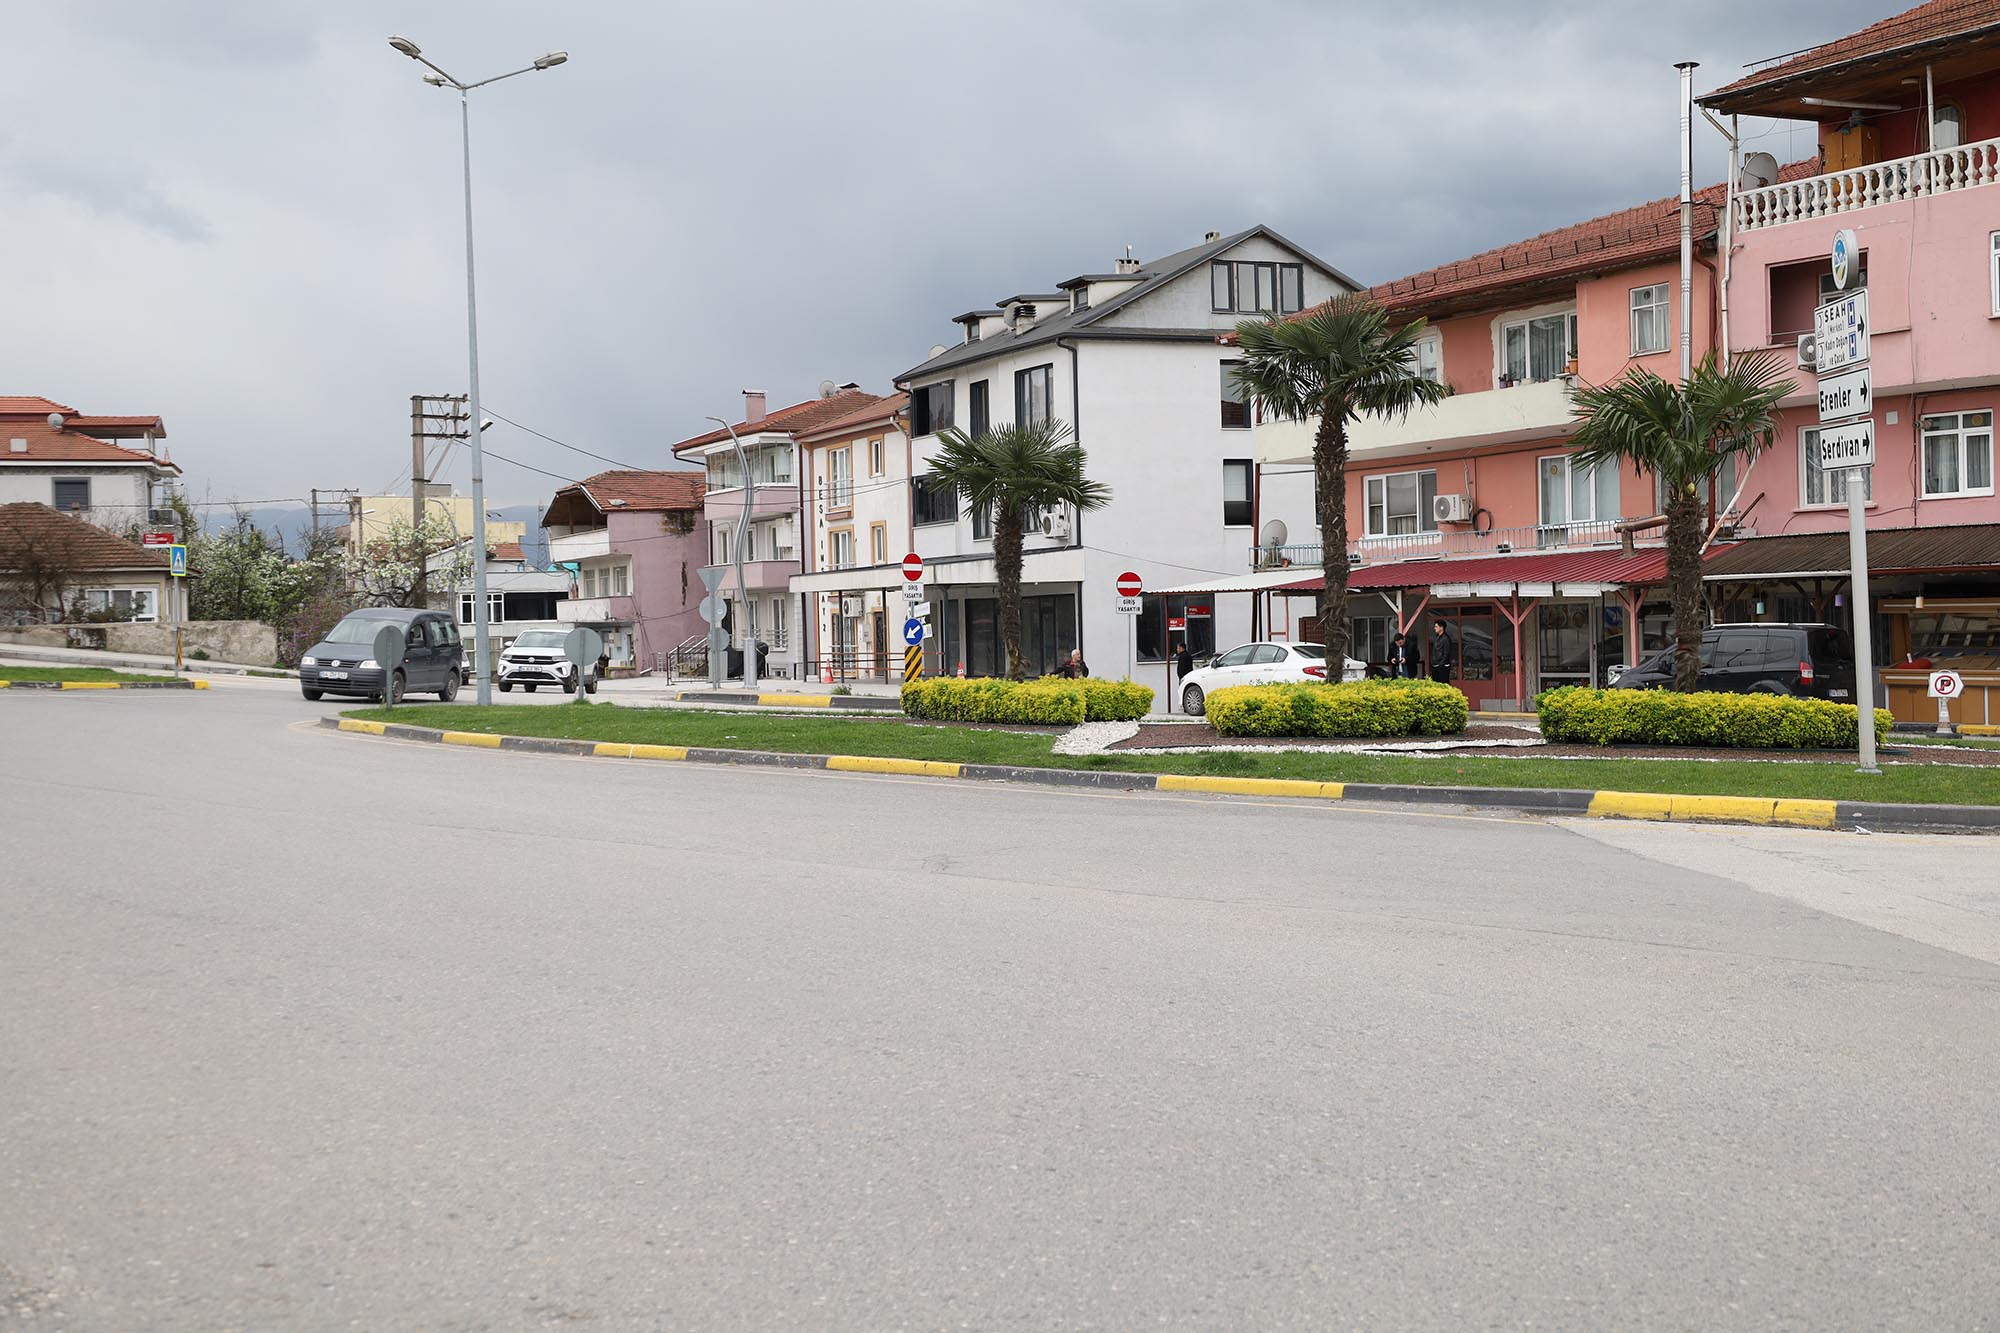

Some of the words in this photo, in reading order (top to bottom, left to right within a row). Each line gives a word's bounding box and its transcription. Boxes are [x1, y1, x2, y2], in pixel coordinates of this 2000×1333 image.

[1824, 302, 1846, 322] SEAH
[1820, 386, 1851, 412] Erenler
[1822, 435, 1860, 460] Serdivan
